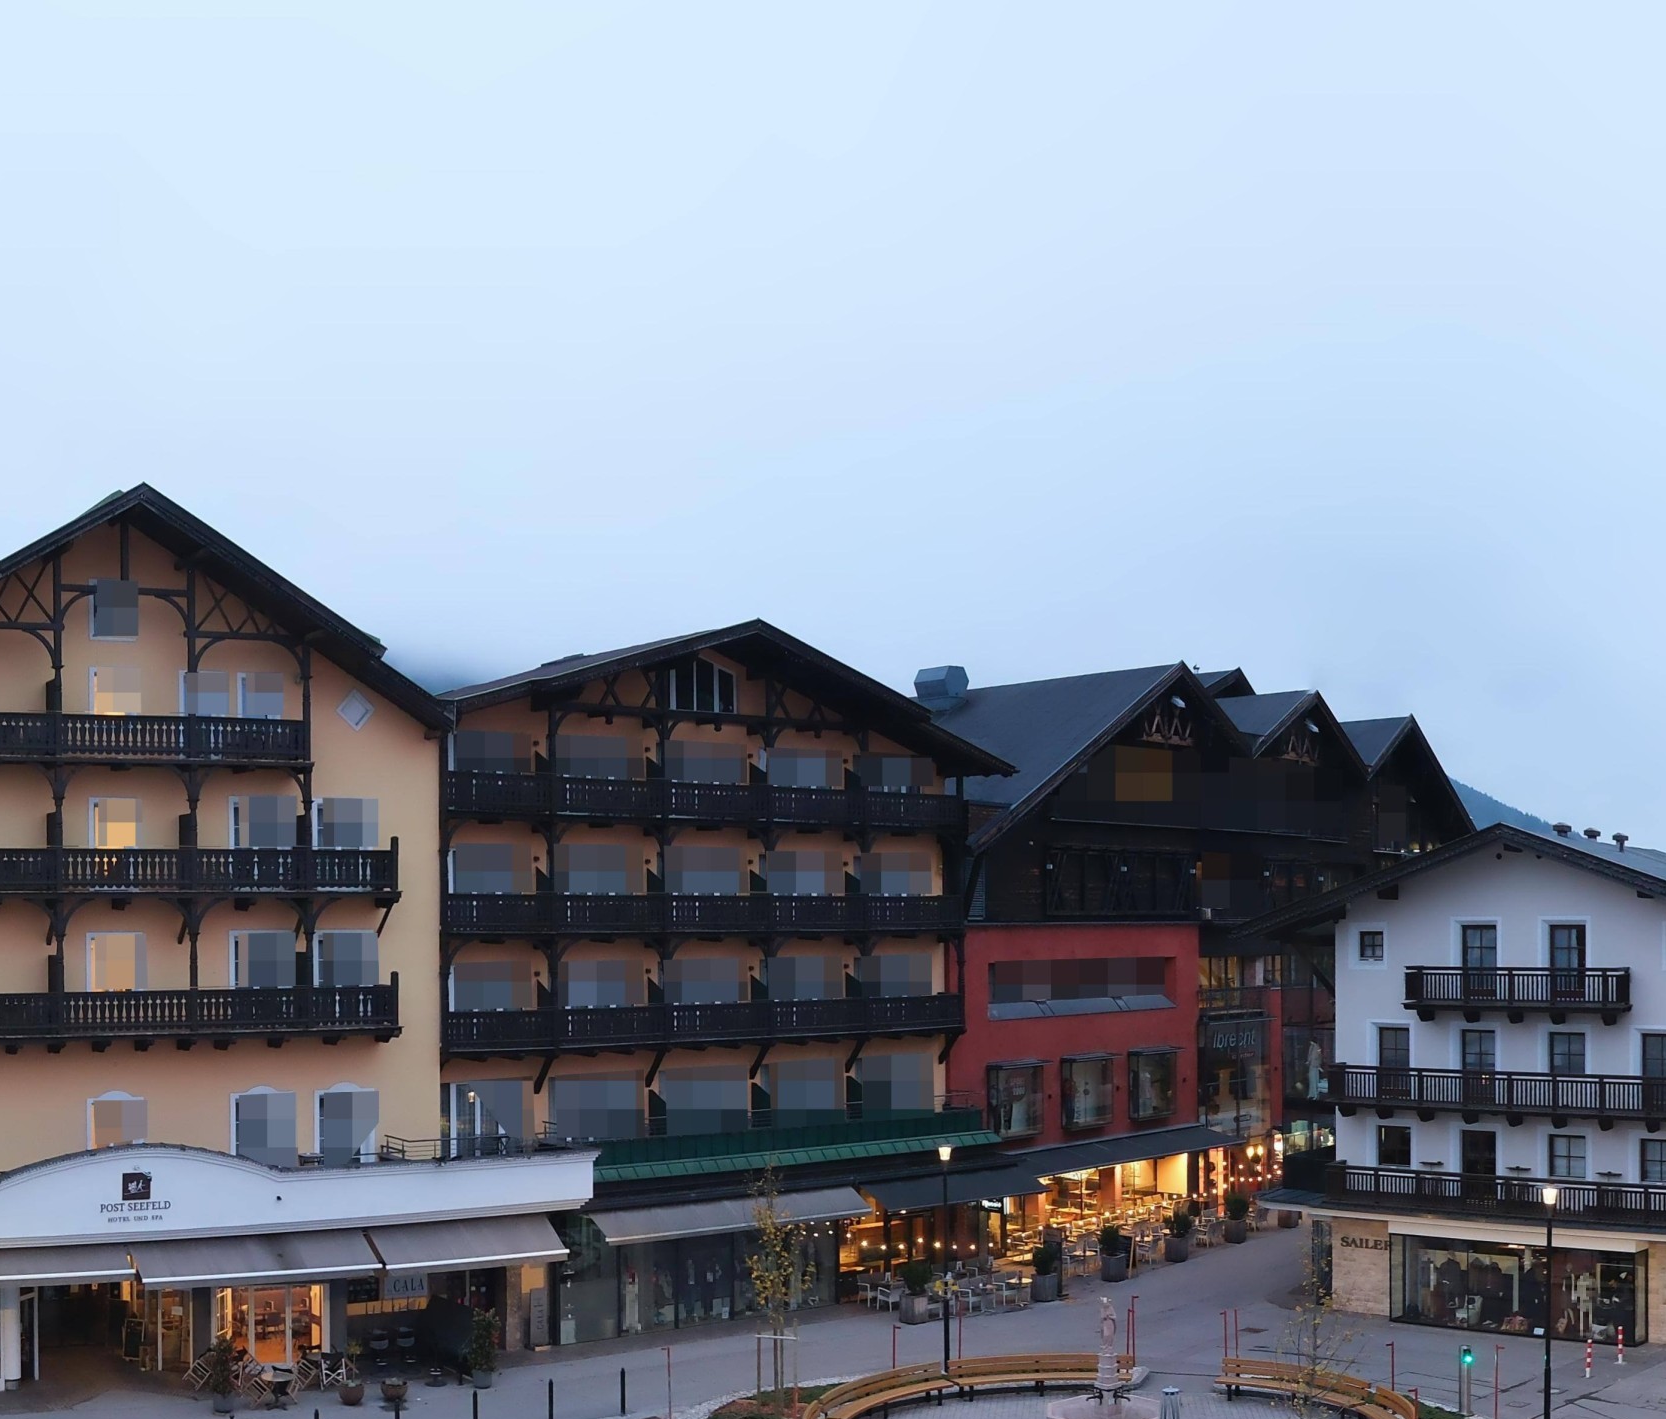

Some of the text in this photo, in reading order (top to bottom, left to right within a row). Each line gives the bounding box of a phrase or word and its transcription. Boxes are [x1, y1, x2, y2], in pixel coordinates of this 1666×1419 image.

[100, 1200, 171, 1213] POST SEEFELD
[393, 1277, 425, 1293] CALA
